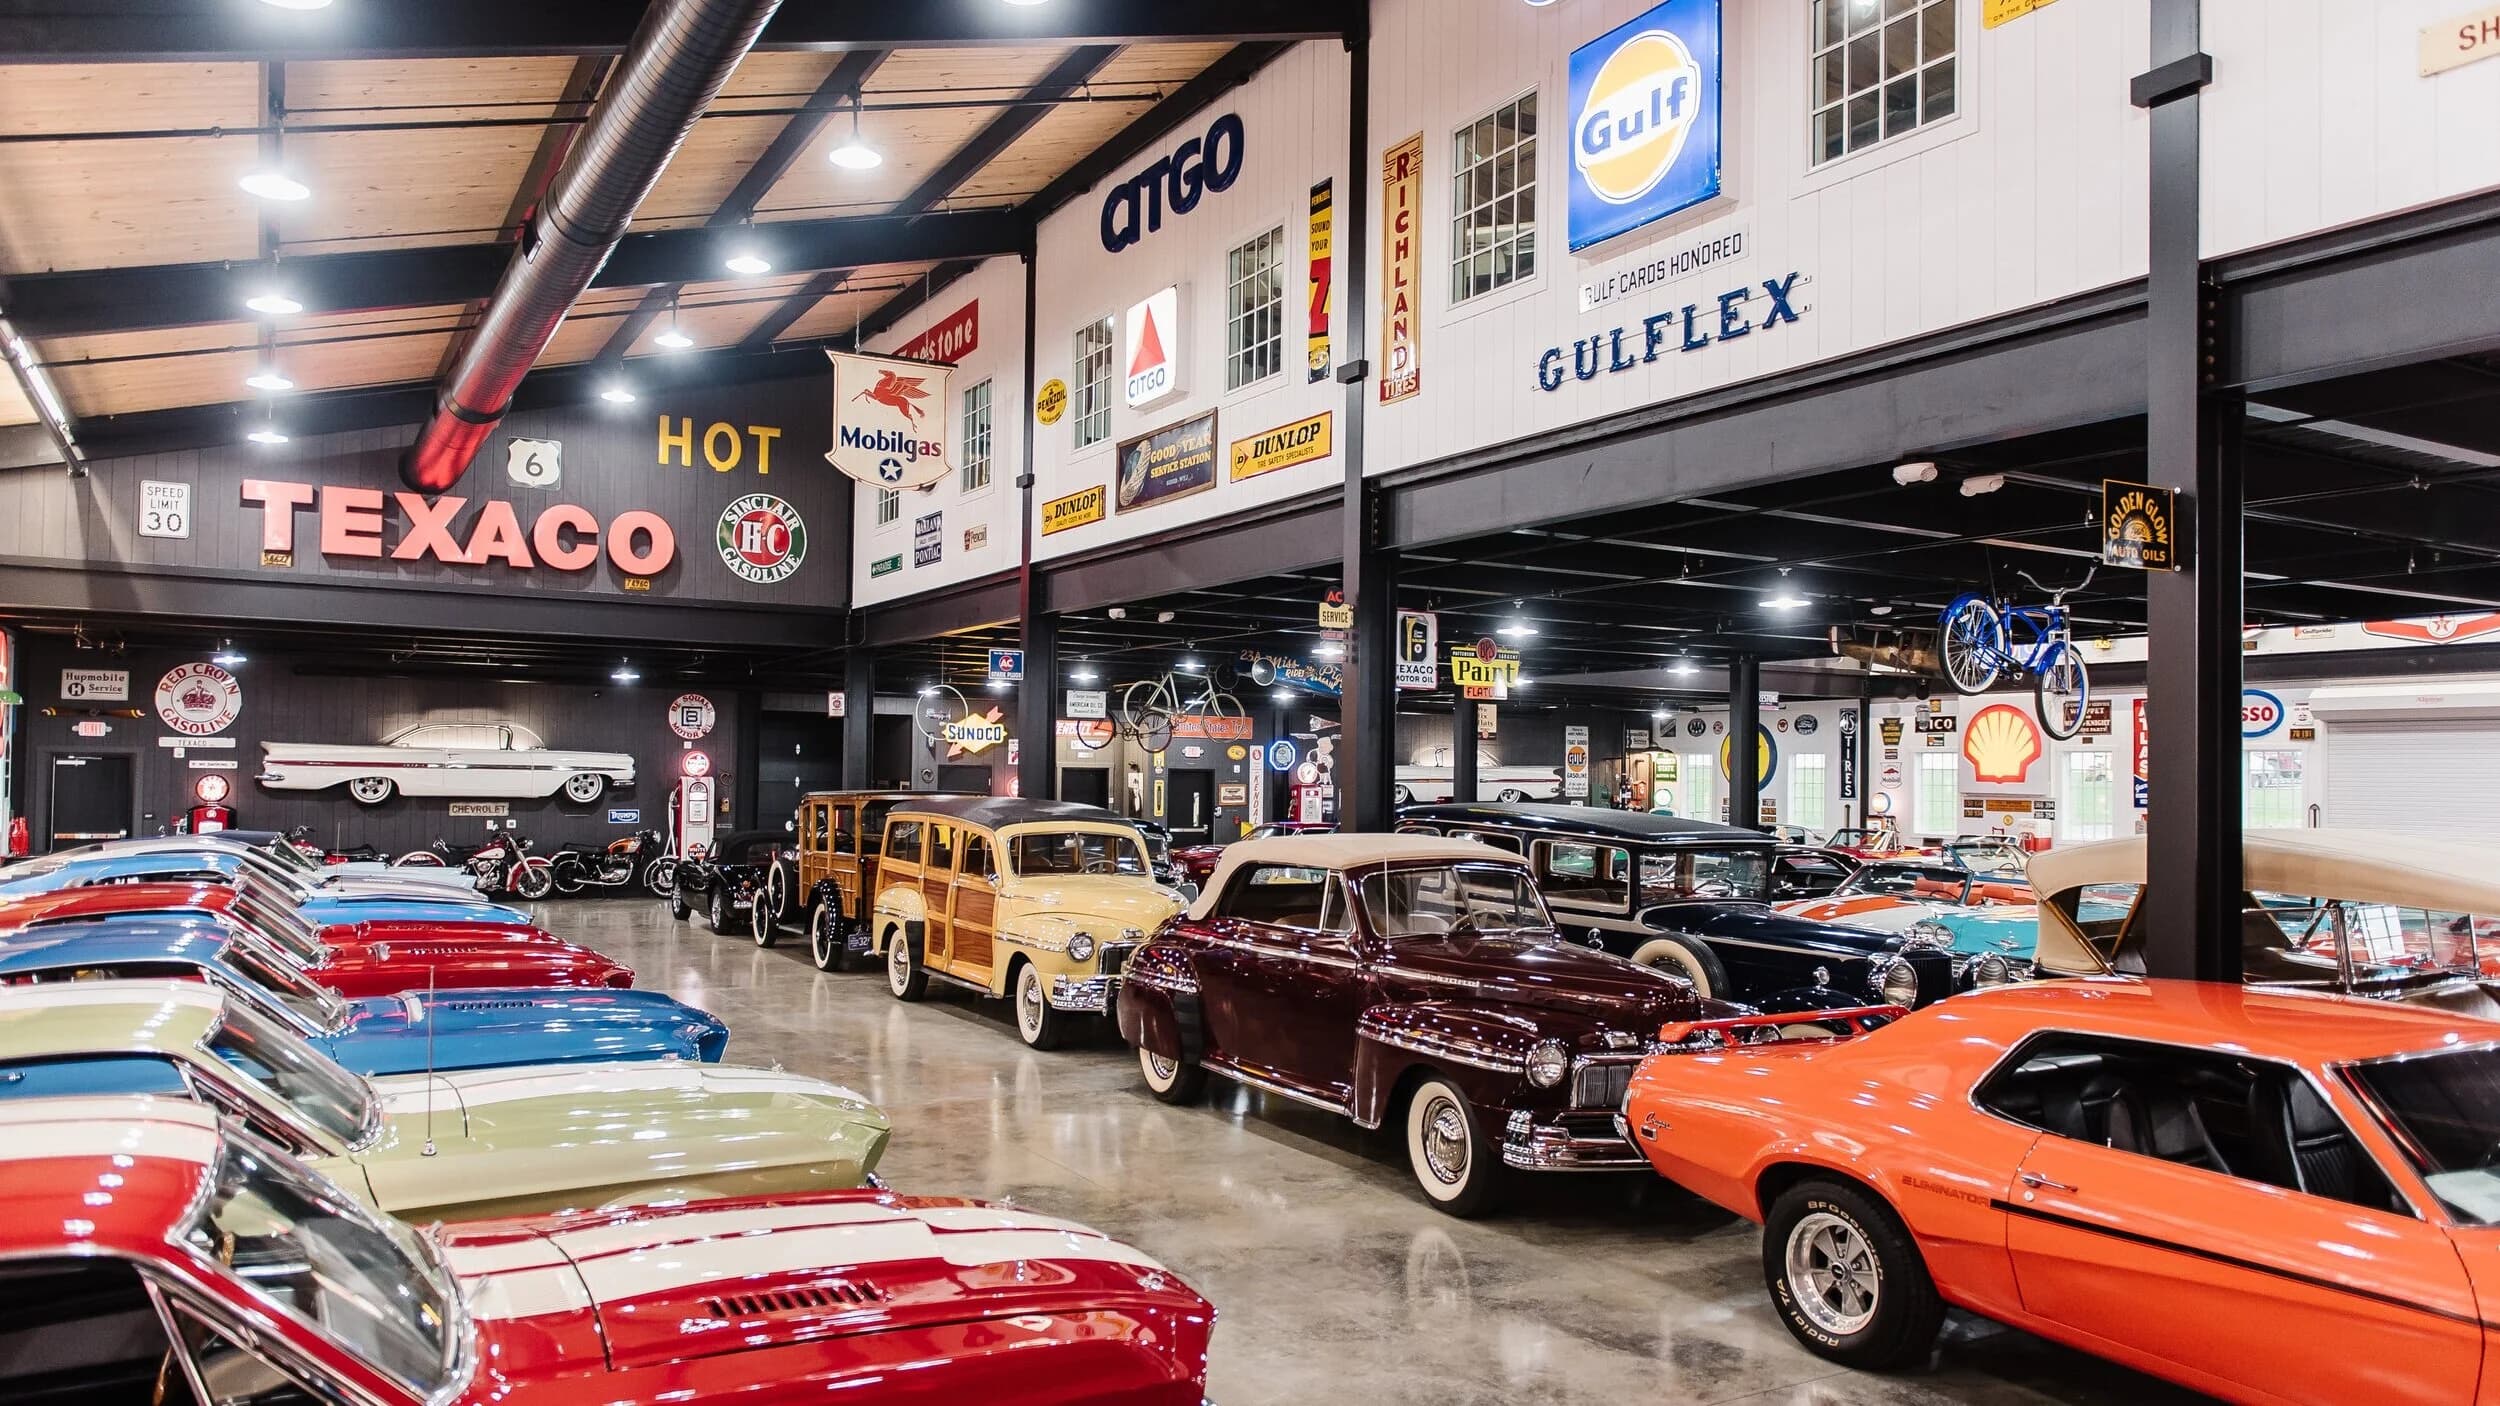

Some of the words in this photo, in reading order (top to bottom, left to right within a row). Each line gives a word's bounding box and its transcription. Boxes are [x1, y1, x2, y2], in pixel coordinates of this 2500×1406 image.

[1582, 77, 1687, 155] Gulf
[1101, 113, 1244, 253] CITGO
[1311, 220, 1330, 235] SOUND
[1311, 239, 1328, 252] YOUR
[1393, 151, 1410, 371] RICHLAND
[1584, 278, 1616, 305] GULF
[1620, 261, 1665, 293] CARDS
[1671, 233, 1742, 276] HONORED
[1309, 257, 1331, 335] Z
[1538, 271, 1799, 392] GULFLEX
[1128, 367, 1165, 399] CITGO
[1384, 373, 1416, 398] TIRES
[1037, 389, 1066, 412] PENNZOIL
[658, 415, 781, 474] HOT
[840, 425, 942, 463] Mobilgas
[1150, 444, 1177, 464] GOOD
[1181, 432, 1213, 453] YEAR
[1253, 422, 1321, 459] DUNLOP
[525, 452, 544, 477] 6
[1150, 461, 1179, 479] SERVICE
[1179, 450, 1212, 469] STATION
[1268, 454, 1285, 466] SAFETY
[1286, 446, 1315, 461] SPECIALISTS
[146, 486, 184, 498] SPEED
[150, 501, 179, 512] LIMIT
[724, 495, 801, 531] SINCLAIR
[1055, 492, 1097, 518] DUNLOP
[2109, 491, 2144, 540] GOLDEN
[146, 512, 182, 532] 30
[242, 478, 676, 575] TEXACO
[2145, 498, 2168, 545] GLOW
[723, 546, 800, 582] GASOLINE
[915, 545, 941, 564] PONTIAC
[2111, 545, 2138, 559] AUTO
[2142, 549, 2166, 562] OILS
[1327, 591, 1343, 602] AC
[1322, 610, 1349, 623] SERVICE
[1001, 659, 1014, 668] AC
[1397, 665, 1434, 674] EXACO
[1458, 660, 1515, 683] Paint
[66, 672, 125, 686] Hupmobile
[89, 683, 122, 693] Service
[160, 667, 187, 694] RED
[192, 663, 239, 696] CROWN
[162, 707, 237, 734] GASOLINE
[671, 721, 700, 738] MOTOR
[949, 725, 1001, 741] SUNOCO
[1568, 752, 1586, 764] GULF
[1844, 736, 1853, 797] TIRES
[452, 804, 506, 816] CHEVROLET
[1902, 1175, 1990, 1208] ELIMINATOR
